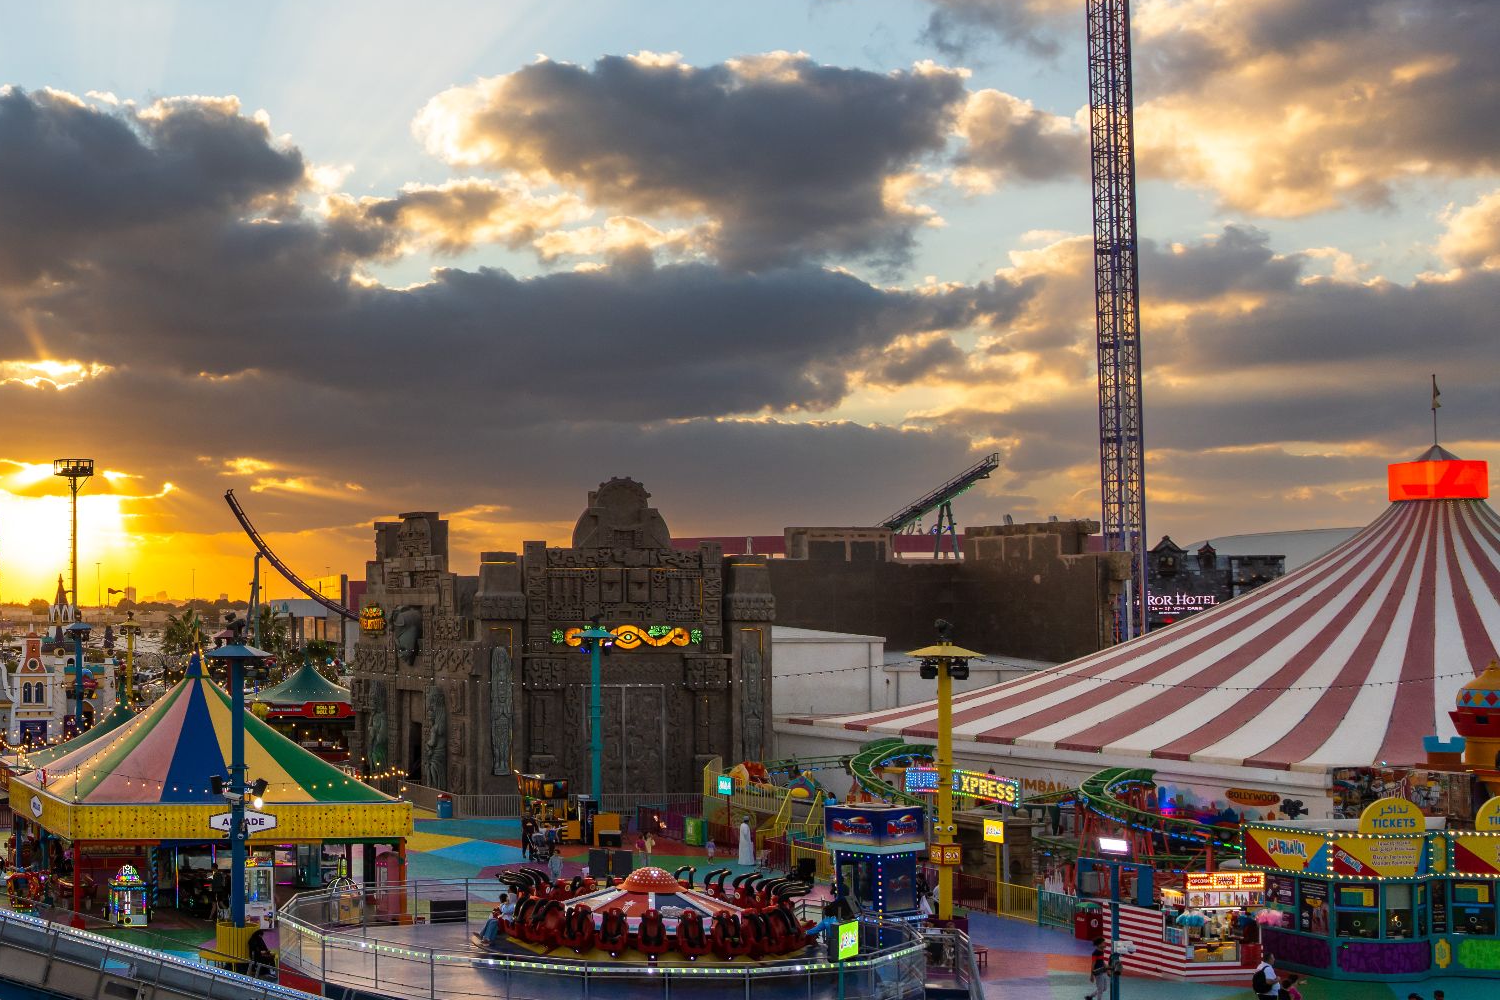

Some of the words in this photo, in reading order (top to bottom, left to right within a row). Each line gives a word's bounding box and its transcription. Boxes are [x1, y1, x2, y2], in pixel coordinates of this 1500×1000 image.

[1175, 592, 1220, 605] HOTEL
[960, 775, 1016, 802] XPRESS
[1228, 791, 1280, 802] BOLLYWOOD
[221, 817, 265, 826] AADE
[1372, 818, 1416, 829] TICKETS
